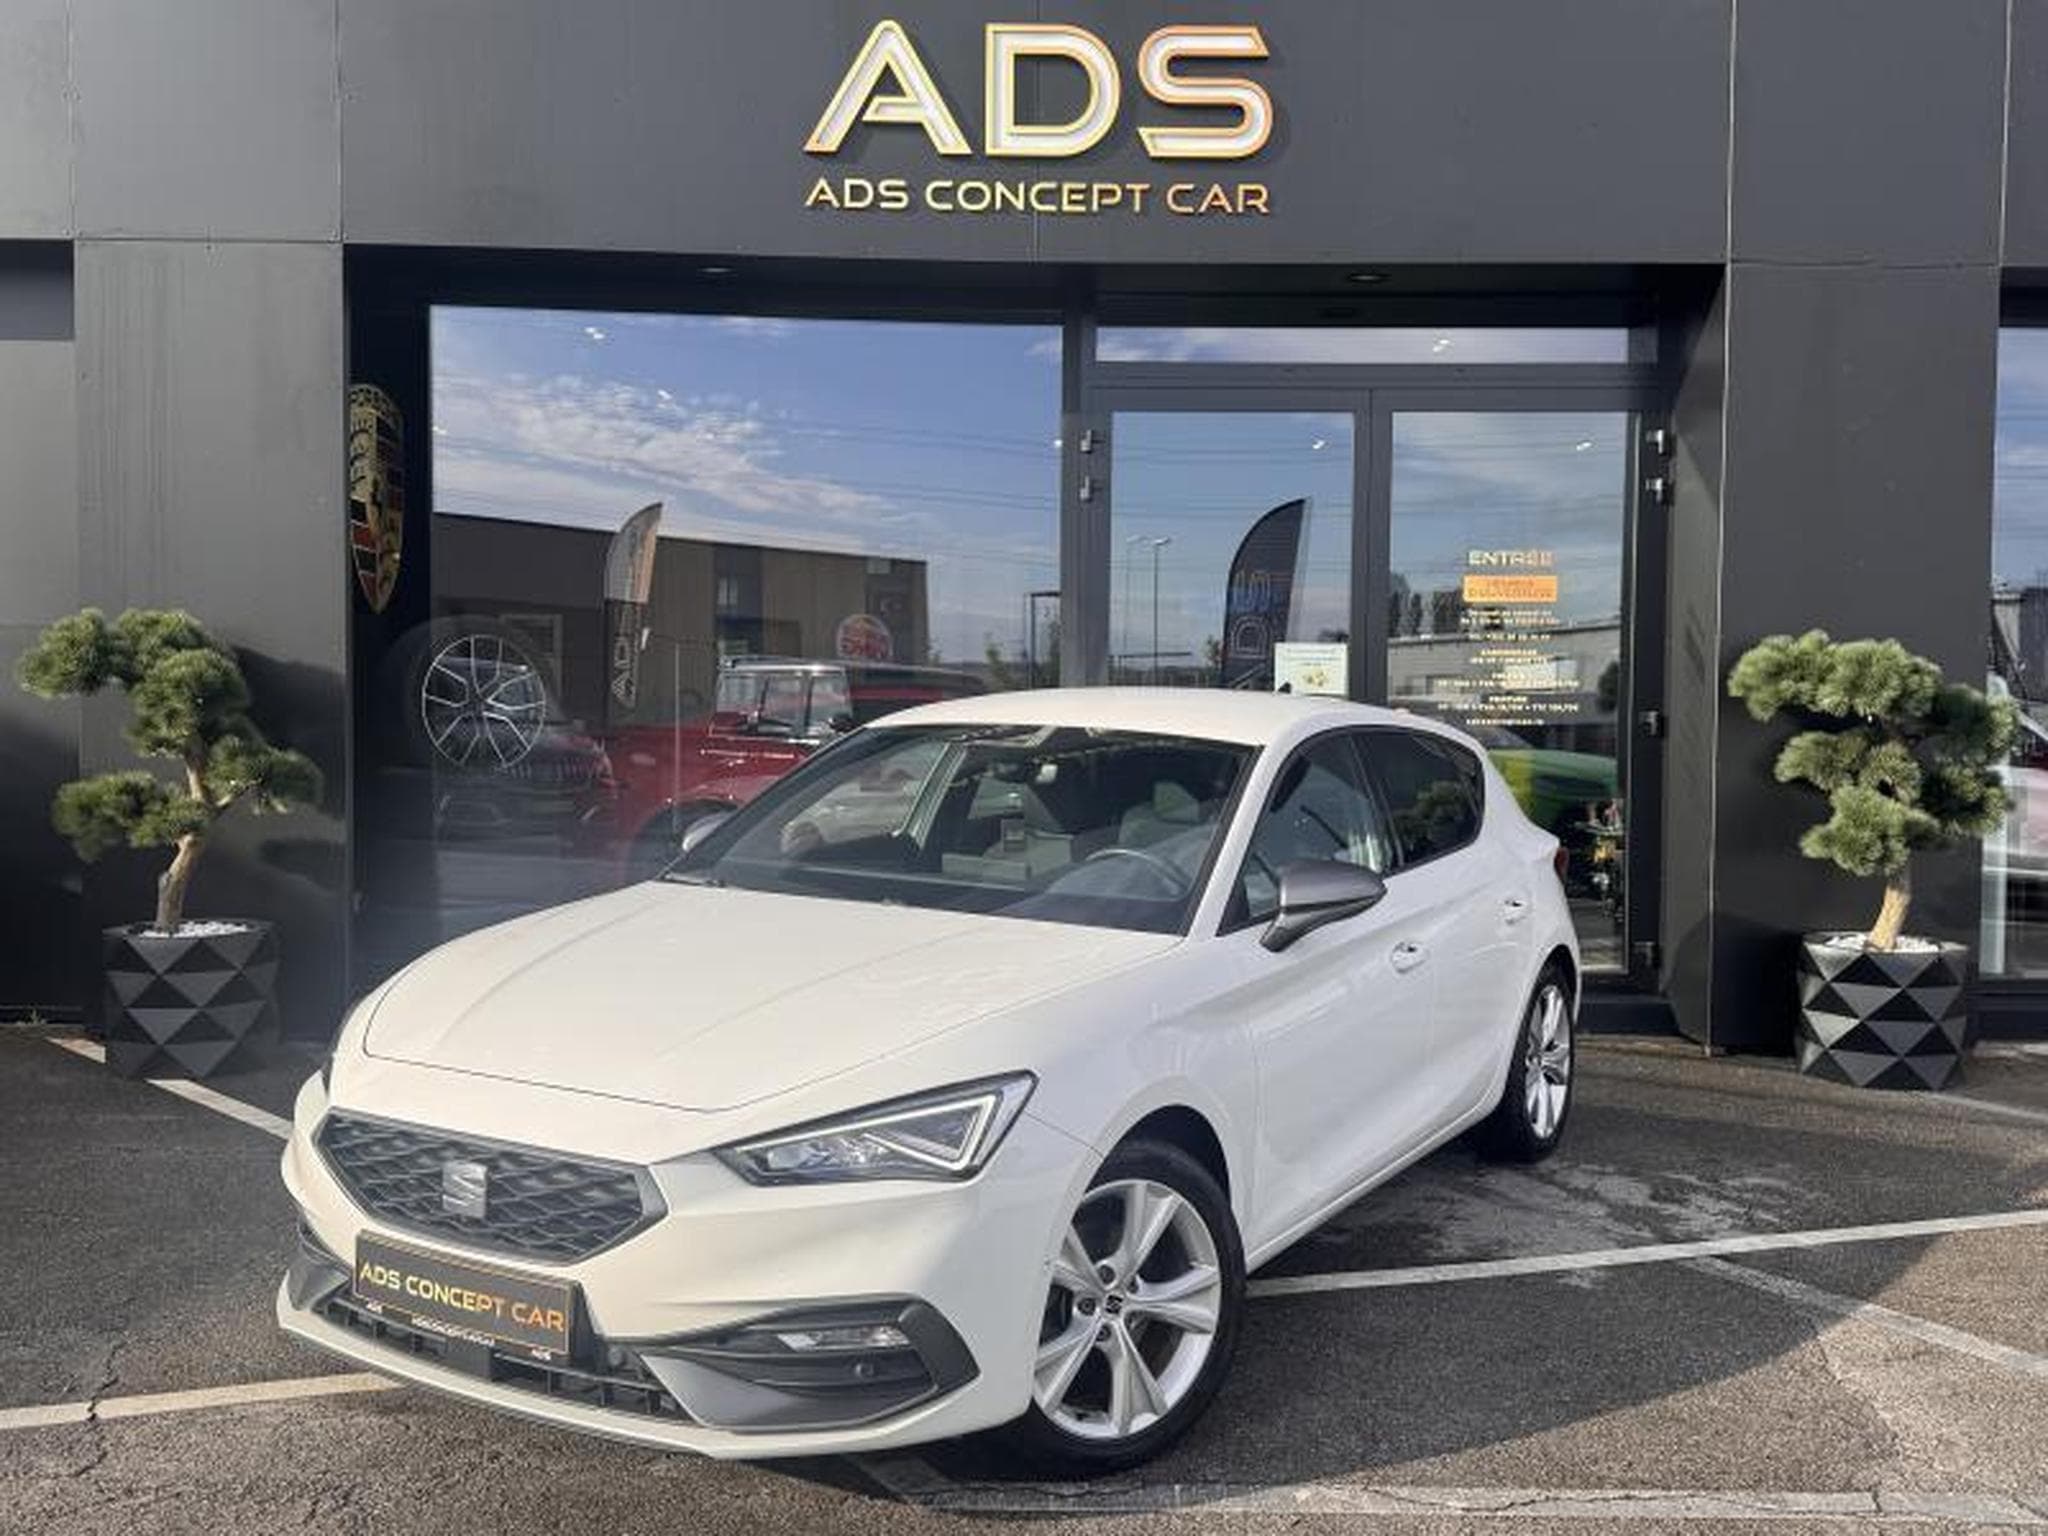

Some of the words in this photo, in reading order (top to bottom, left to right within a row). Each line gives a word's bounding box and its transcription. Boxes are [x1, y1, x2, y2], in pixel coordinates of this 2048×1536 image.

[803, 19, 1273, 158] ADS
[804, 178, 909, 211] ADS
[925, 180, 1150, 214] CONCEPT
[1166, 183, 1269, 214] CAR
[360, 1261, 401, 1290] ADS
[405, 1275, 505, 1318] CONCEPT
[511, 1302, 564, 1333] CAR
